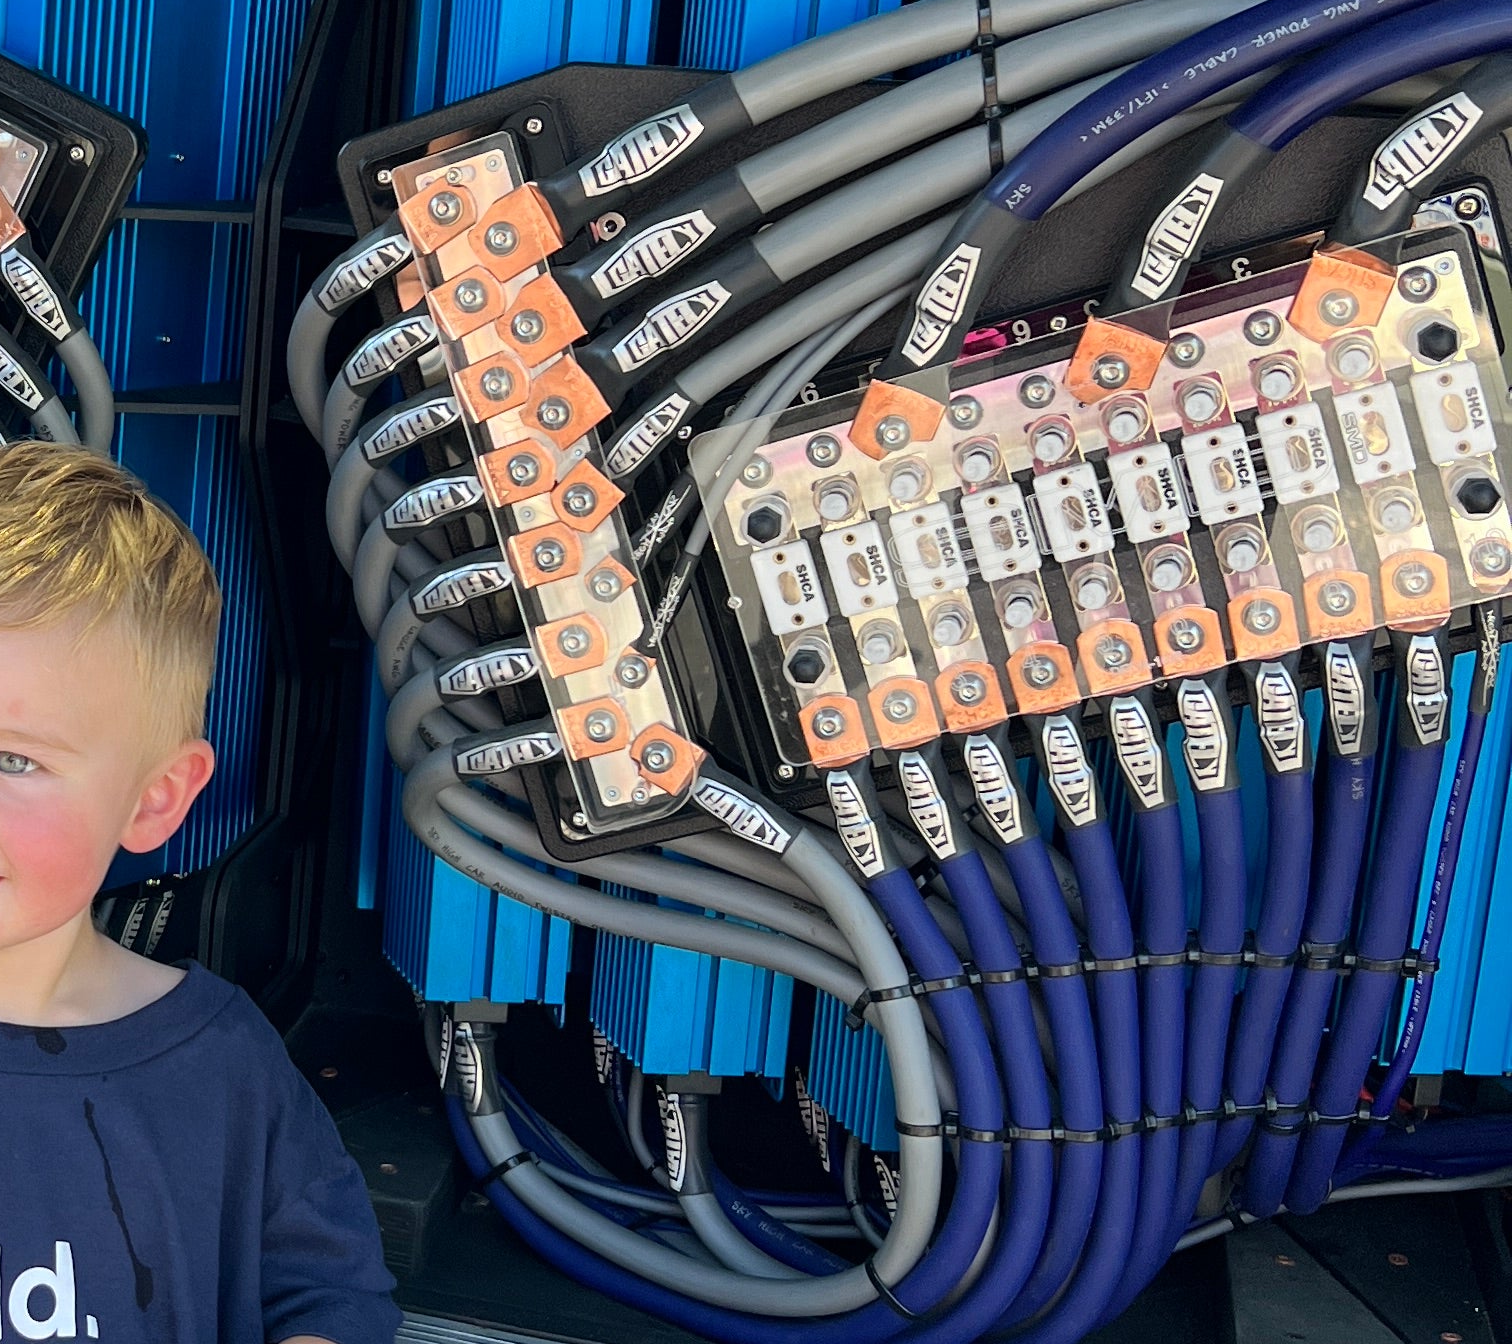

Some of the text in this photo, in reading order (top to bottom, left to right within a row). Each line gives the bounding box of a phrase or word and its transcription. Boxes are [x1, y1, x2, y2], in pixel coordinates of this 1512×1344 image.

[1251, 17, 1311, 48] POWER
[1323, 0, 1361, 20] AWG
[1183, 47, 1238, 80] CABLE
[591, 113, 690, 188] GATELY
[1372, 104, 1468, 195] GATELY
[1005, 183, 1032, 209] SKY
[604, 219, 702, 289] GATELY
[1141, 186, 1213, 286] GATELY
[6, 258, 64, 331] GATELY
[327, 242, 406, 304] GATELY
[625, 290, 718, 364] GATELY
[911, 256, 970, 353] GATELY
[353, 322, 430, 379] GATELY
[374, 403, 456, 453] GATELY
[1465, 386, 1485, 430] SHCA
[608, 403, 680, 473] GATELY
[1307, 427, 1327, 470] SHCA
[1341, 412, 1368, 465] SMD
[1157, 468, 1178, 510] SHCA
[1231, 448, 1252, 490] SHCA
[394, 482, 475, 524] GATELY
[1010, 508, 1030, 549] SHCA
[1083, 488, 1102, 529] SHCA
[866, 545, 888, 586] SHCA
[935, 526, 958, 569] SHCA
[422, 568, 505, 610] GATELY
[795, 564, 816, 603] SHCA
[449, 654, 533, 691] GATELY
[1330, 653, 1360, 744] GATELY
[1411, 649, 1444, 734] GATELY
[1182, 690, 1221, 779] GATELY
[1261, 673, 1297, 761] GATELY
[467, 739, 555, 770] GATELY
[1048, 726, 1088, 816] GATELY
[1115, 707, 1157, 796] GATELY
[695, 784, 780, 845] GATELY
[904, 763, 948, 848] GATELY
[969, 745, 1015, 832] GATELY
[831, 782, 877, 866] GATELY
